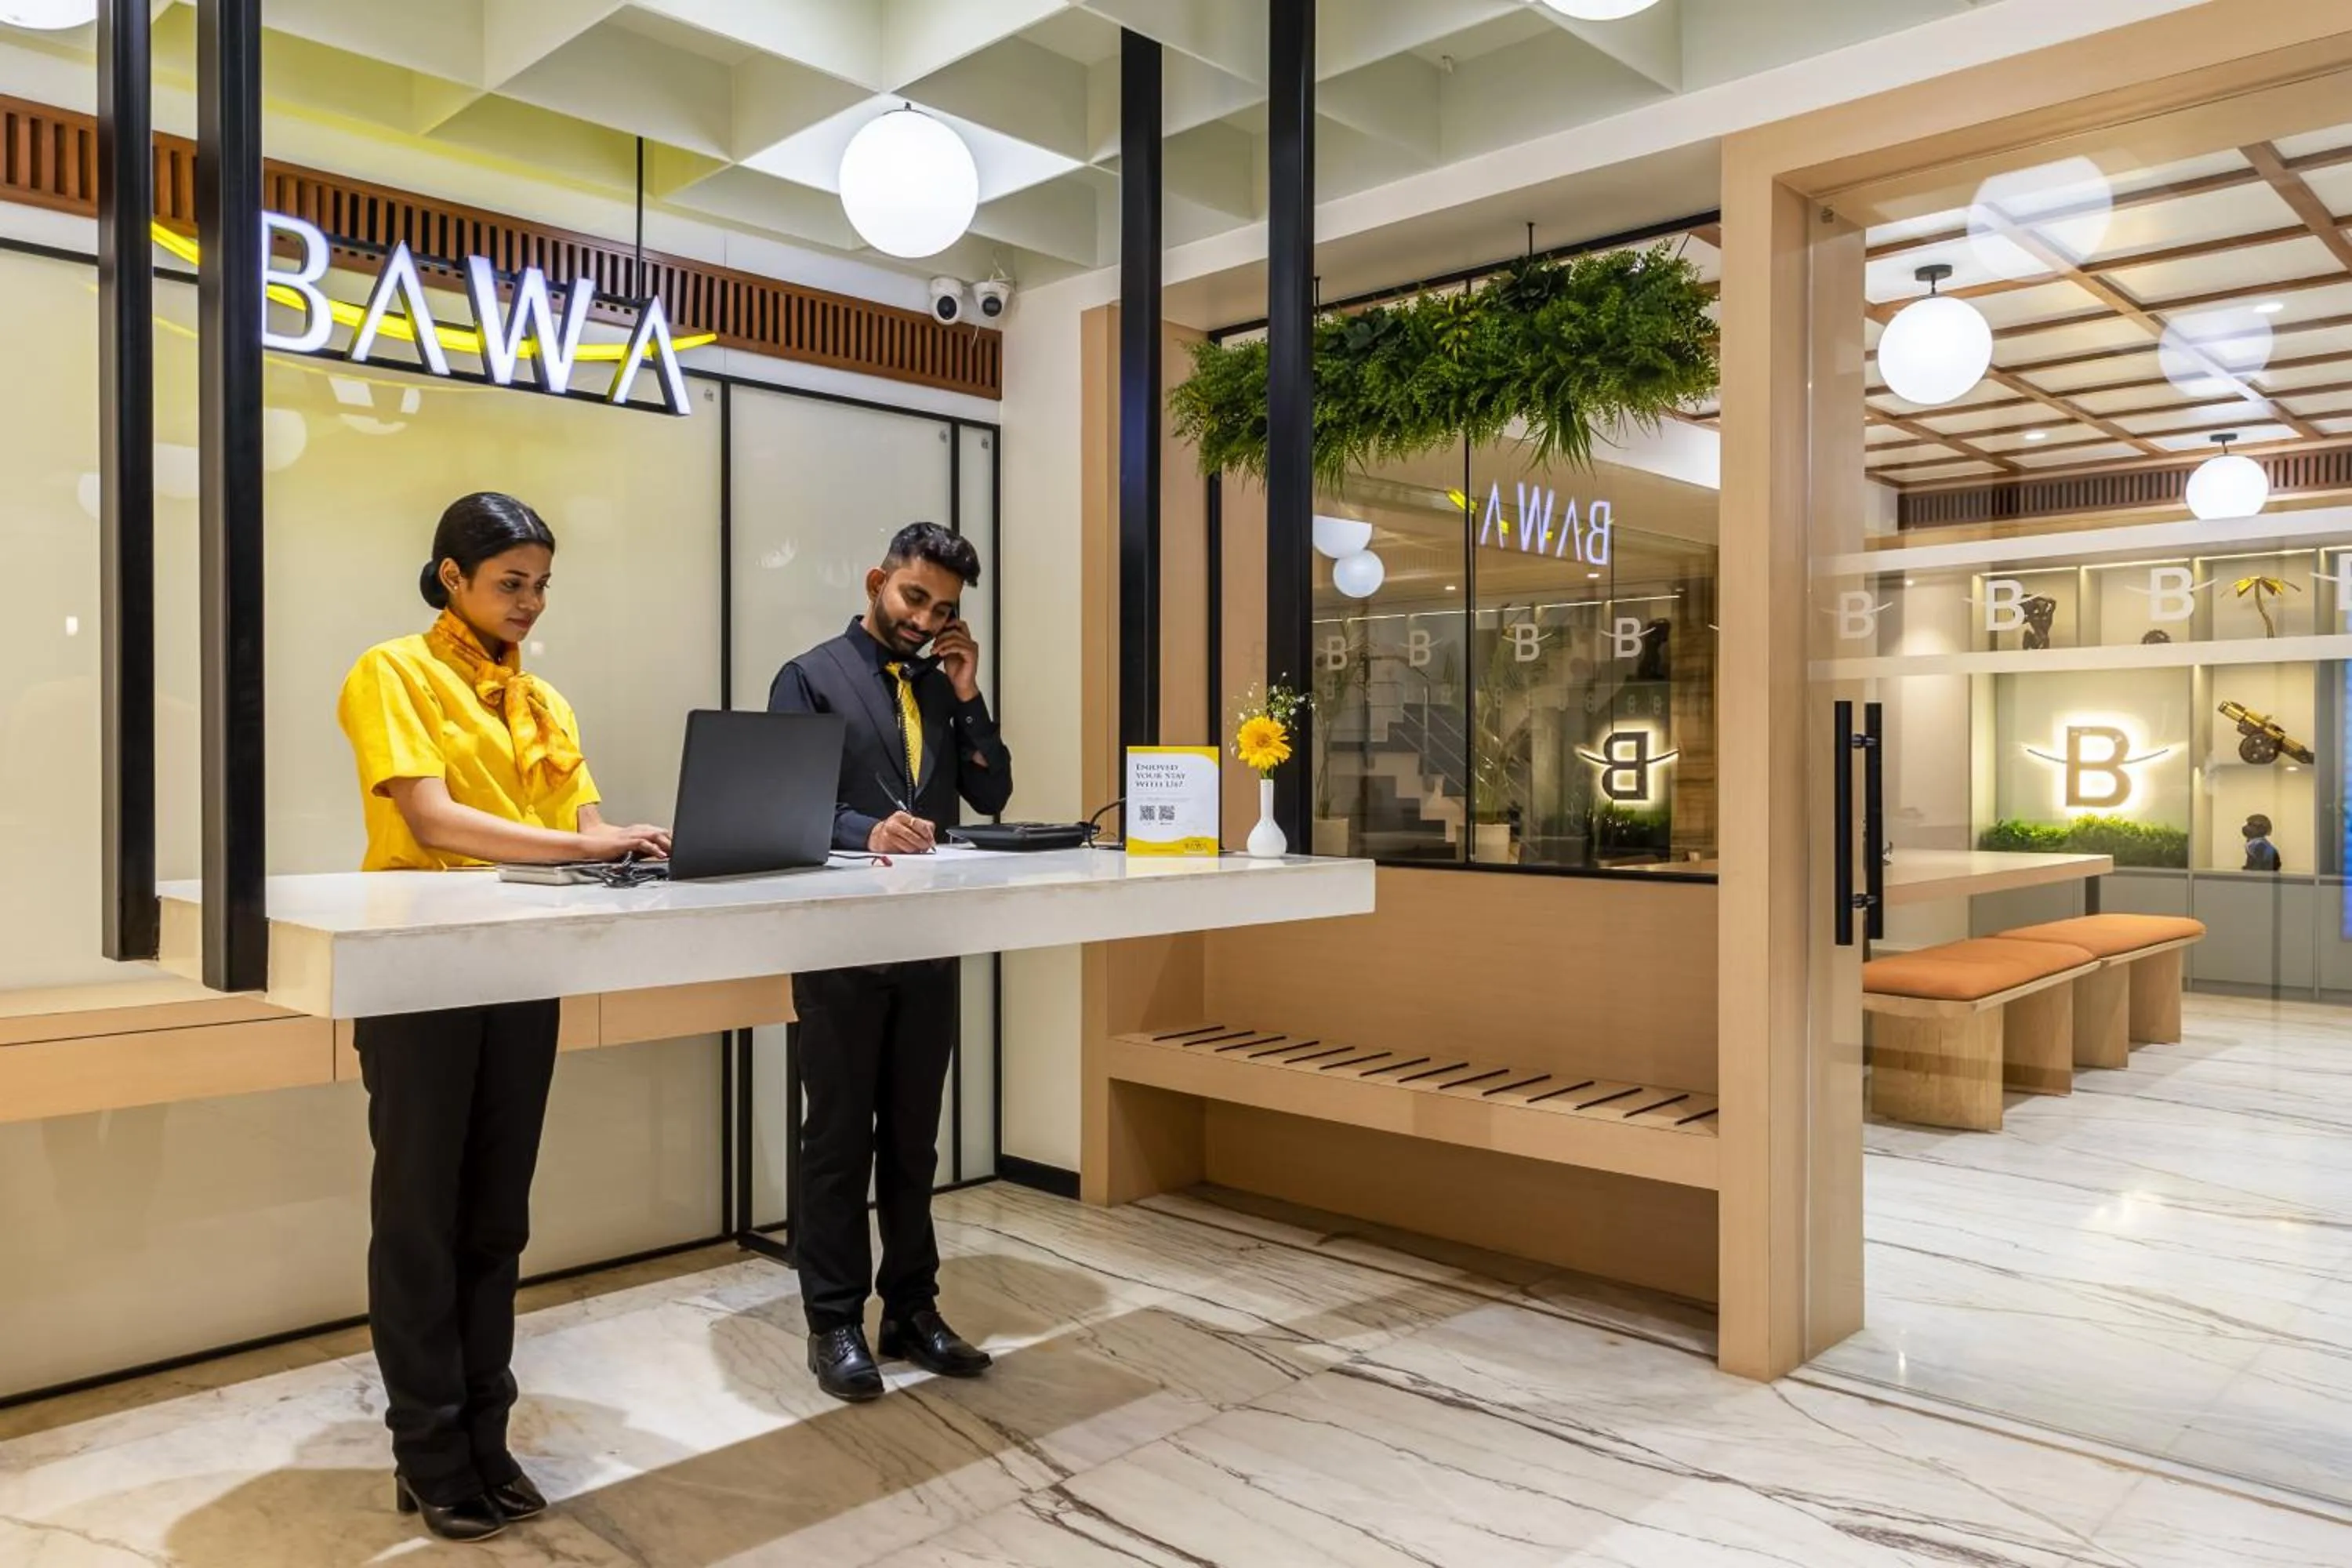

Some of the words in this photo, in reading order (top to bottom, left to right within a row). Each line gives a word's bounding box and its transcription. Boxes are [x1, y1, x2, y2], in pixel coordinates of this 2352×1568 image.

[262, 210, 690, 416] BAWA
[1838, 591, 1875, 640] B
[1985, 579, 2026, 631] B
[2148, 567, 2194, 622] B
[1327, 636, 1348, 670] B
[1409, 630, 1431, 666] B
[1515, 623, 1540, 662] B
[1614, 618, 1642, 658] B
[2064, 725, 2132, 808] B
